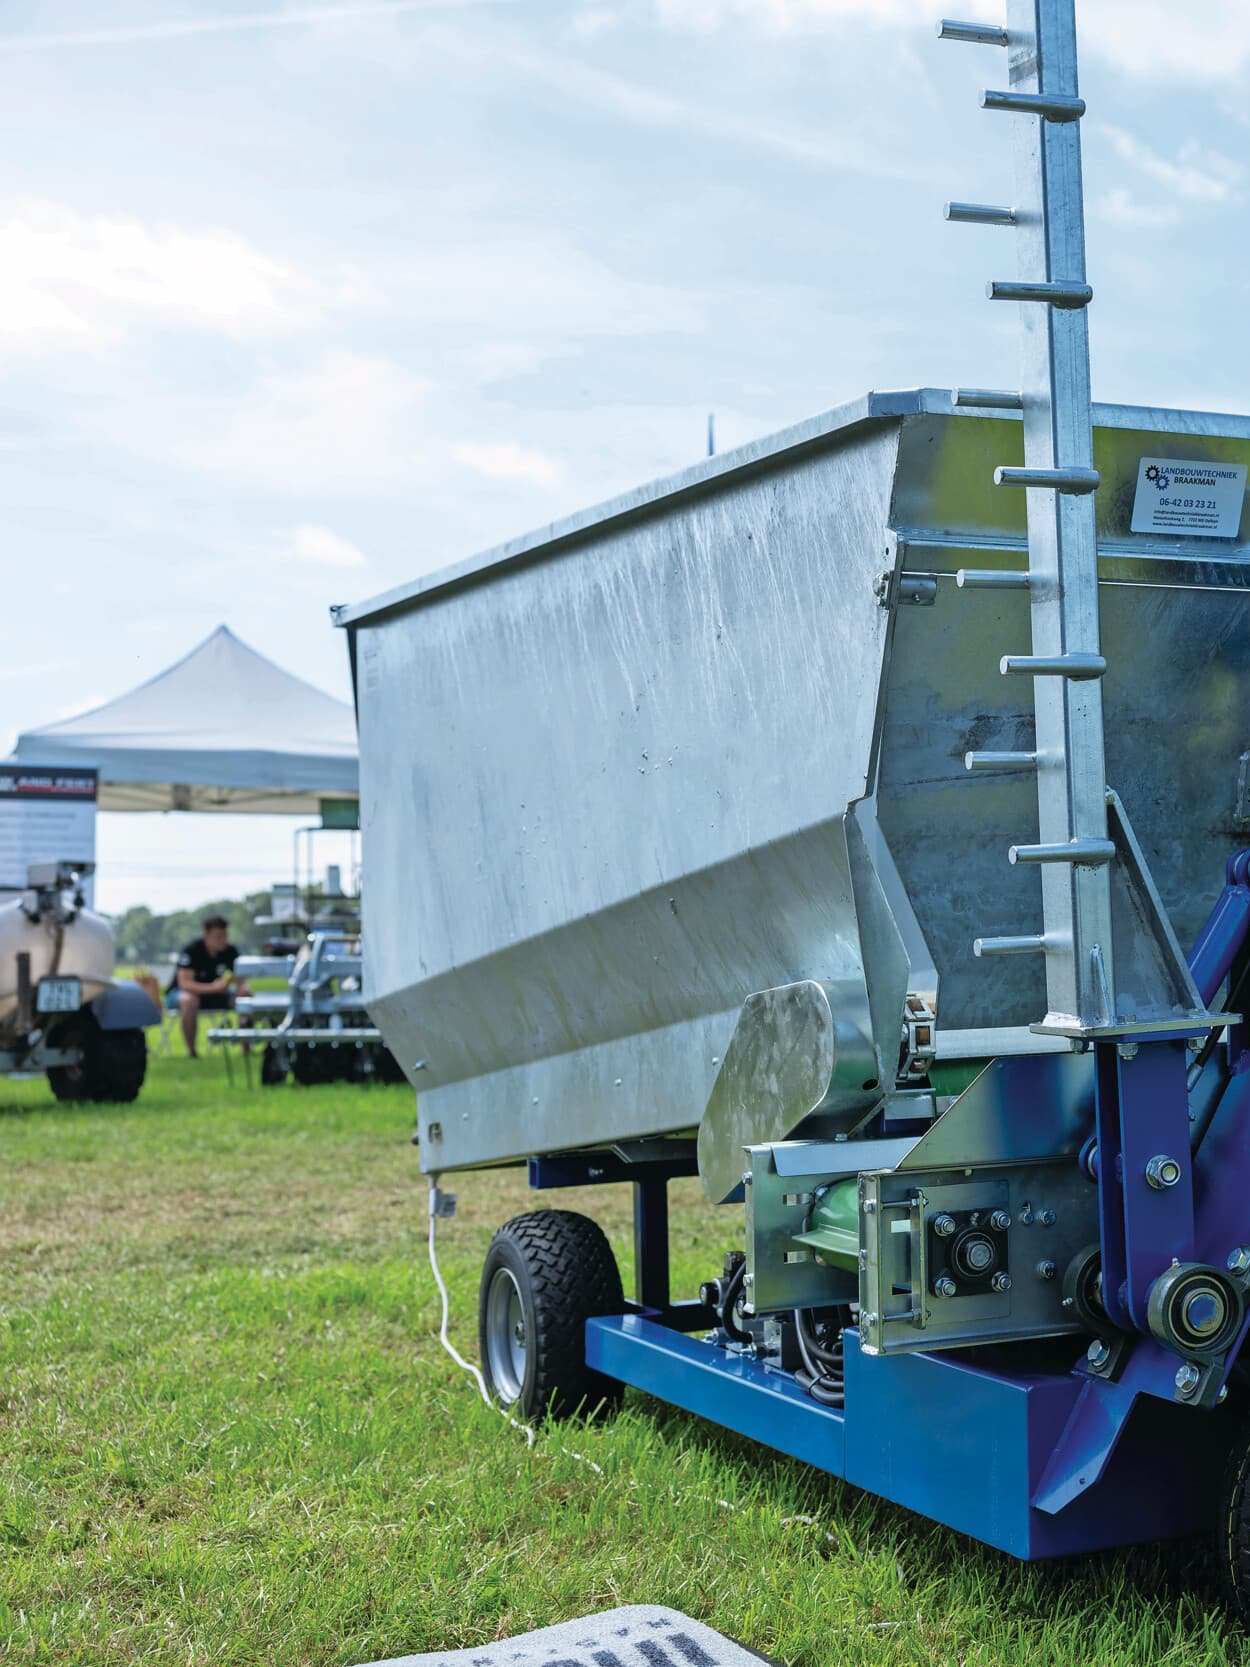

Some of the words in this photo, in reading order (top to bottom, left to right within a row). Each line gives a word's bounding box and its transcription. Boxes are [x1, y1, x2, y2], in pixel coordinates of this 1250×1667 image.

[1161, 467, 1238, 479] LANDBOUWTECHNIEK
[1174, 476, 1216, 486] BRAAKMAN
[1159, 497, 1182, 507] 06-42
[1183, 499, 1194, 508] 03
[1195, 500, 1205, 509] 23
[1207, 501, 1217, 509] 21
